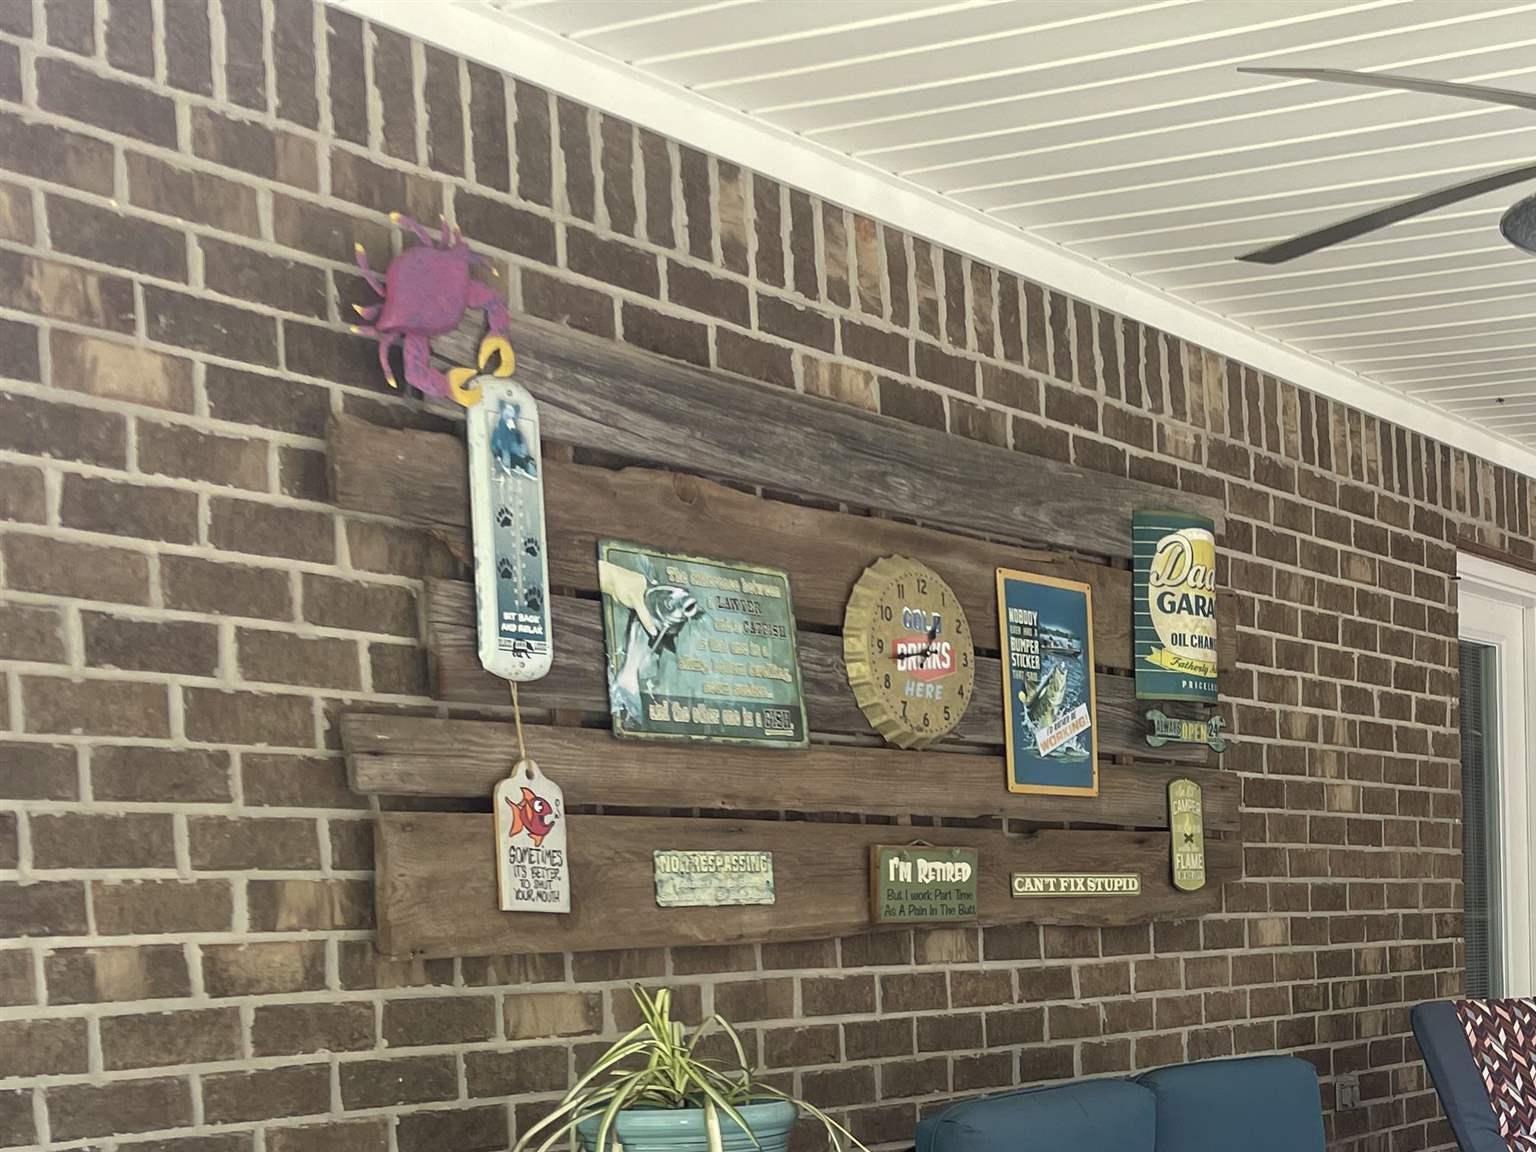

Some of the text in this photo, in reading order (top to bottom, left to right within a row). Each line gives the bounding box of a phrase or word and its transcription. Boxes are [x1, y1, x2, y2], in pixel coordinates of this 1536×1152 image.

[897, 584, 905, 600] 11
[916, 578, 928, 596] 12
[880, 605, 893, 622] 10
[902, 606, 943, 634] COLD
[955, 619, 962, 634] 2
[876, 638, 884, 654] 9
[1010, 636, 1040, 655] BUMPER
[1171, 632, 1190, 648] OIL
[896, 641, 951, 671] DRINKS
[962, 652, 969, 668] 3
[1011, 652, 1041, 670] STICKER
[884, 673, 891, 690] 8
[904, 681, 944, 700] HERE
[957, 684, 964, 699] 4
[901, 700, 908, 718] 7
[943, 705, 951, 721] 5
[923, 712, 930, 727] 6
[509, 845, 563, 867] SOMETIMES
[660, 855, 769, 873] NO TRESPASSING
[531, 865, 561, 881] BETTER
[888, 856, 912, 883] I'M
[520, 879, 553, 890] TO SHUT
[1014, 877, 1139, 892] CAN'T FIX STUPID
[898, 904, 906, 917] A
